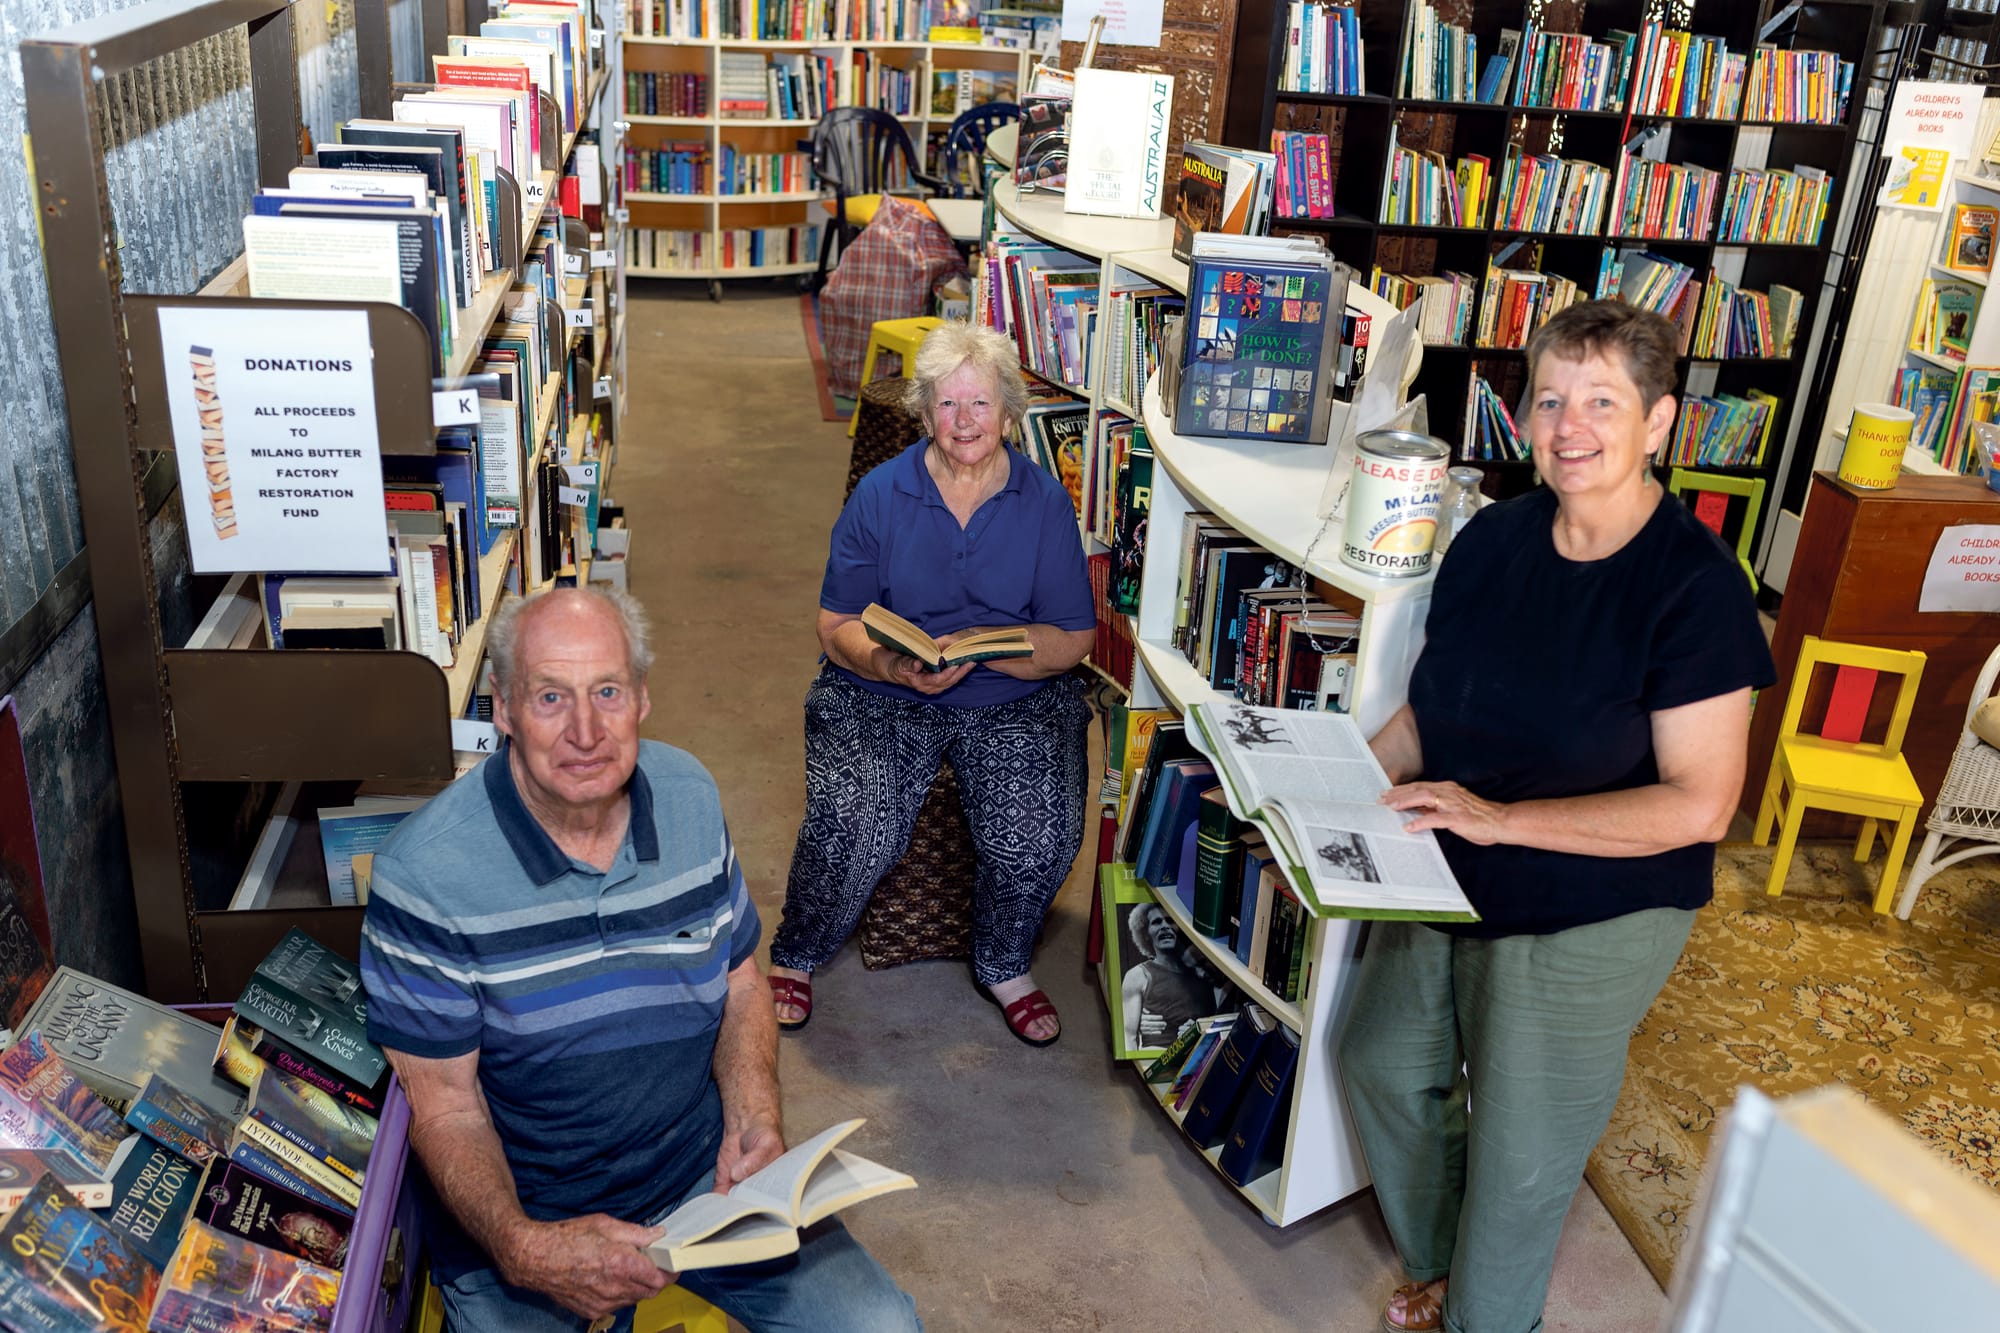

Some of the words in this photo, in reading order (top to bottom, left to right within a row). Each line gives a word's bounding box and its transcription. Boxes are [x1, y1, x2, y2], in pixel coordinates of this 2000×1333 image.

[1154, 80, 1168, 97] II
[1913, 94, 1961, 105] CHILDREN'S
[1905, 108, 1940, 120] ALREADY
[1941, 110, 1964, 121] READ
[1917, 123, 1945, 134] BOOKS
[1143, 100, 1166, 213] AUSTRALIA
[1183, 156, 1223, 185] AUSTRALIA
[567, 254, 576, 264] O
[575, 314, 584, 324] N
[1242, 334, 1283, 350] HOW
[1287, 335, 1301, 350] IS
[1239, 348, 1259, 361] IT
[1260, 350, 1312, 365] DONE?
[245, 359, 353, 373] DONATIONS
[254, 406, 280, 417] ALL
[284, 407, 356, 417] PROCEEDS
[459, 398, 472, 414] K
[289, 428, 309, 438] TO
[1857, 428, 1890, 443] THANK
[250, 448, 305, 458] MILANG
[308, 448, 362, 458] BUTTER
[560, 450, 567, 458] P
[276, 468, 339, 479] FACTORY
[584, 468, 593, 477] O
[1354, 455, 1425, 483] PLEASE
[1843, 472, 1886, 488] ALREADY
[258, 488, 354, 499] RESTORATION
[576, 493, 586, 504] M
[283, 508, 320, 518] FUND
[1947, 555, 1996, 567] ALREADY
[1964, 572, 2000, 583] BOOKS
[476, 737, 489, 750] K
[250, 983, 283, 1007] GEORGE
[43, 982, 95, 1042] ALMANAC
[242, 989, 294, 1027] MARTIN
[72, 1018, 90, 1038] OF
[84, 1004, 103, 1026] THE
[71, 996, 128, 1062] UNCANNY
[330, 1028, 357, 1049] CLASH
[322, 1035, 355, 1061] KINGS
[278, 1052, 303, 1073] Dark
[302, 1066, 337, 1090] Secrets
[270, 1119, 284, 1132] THE
[261, 1164, 308, 1197] SABERHAGEN
[111, 1198, 134, 1229] THE
[12, 1193, 66, 1258] ORDER
